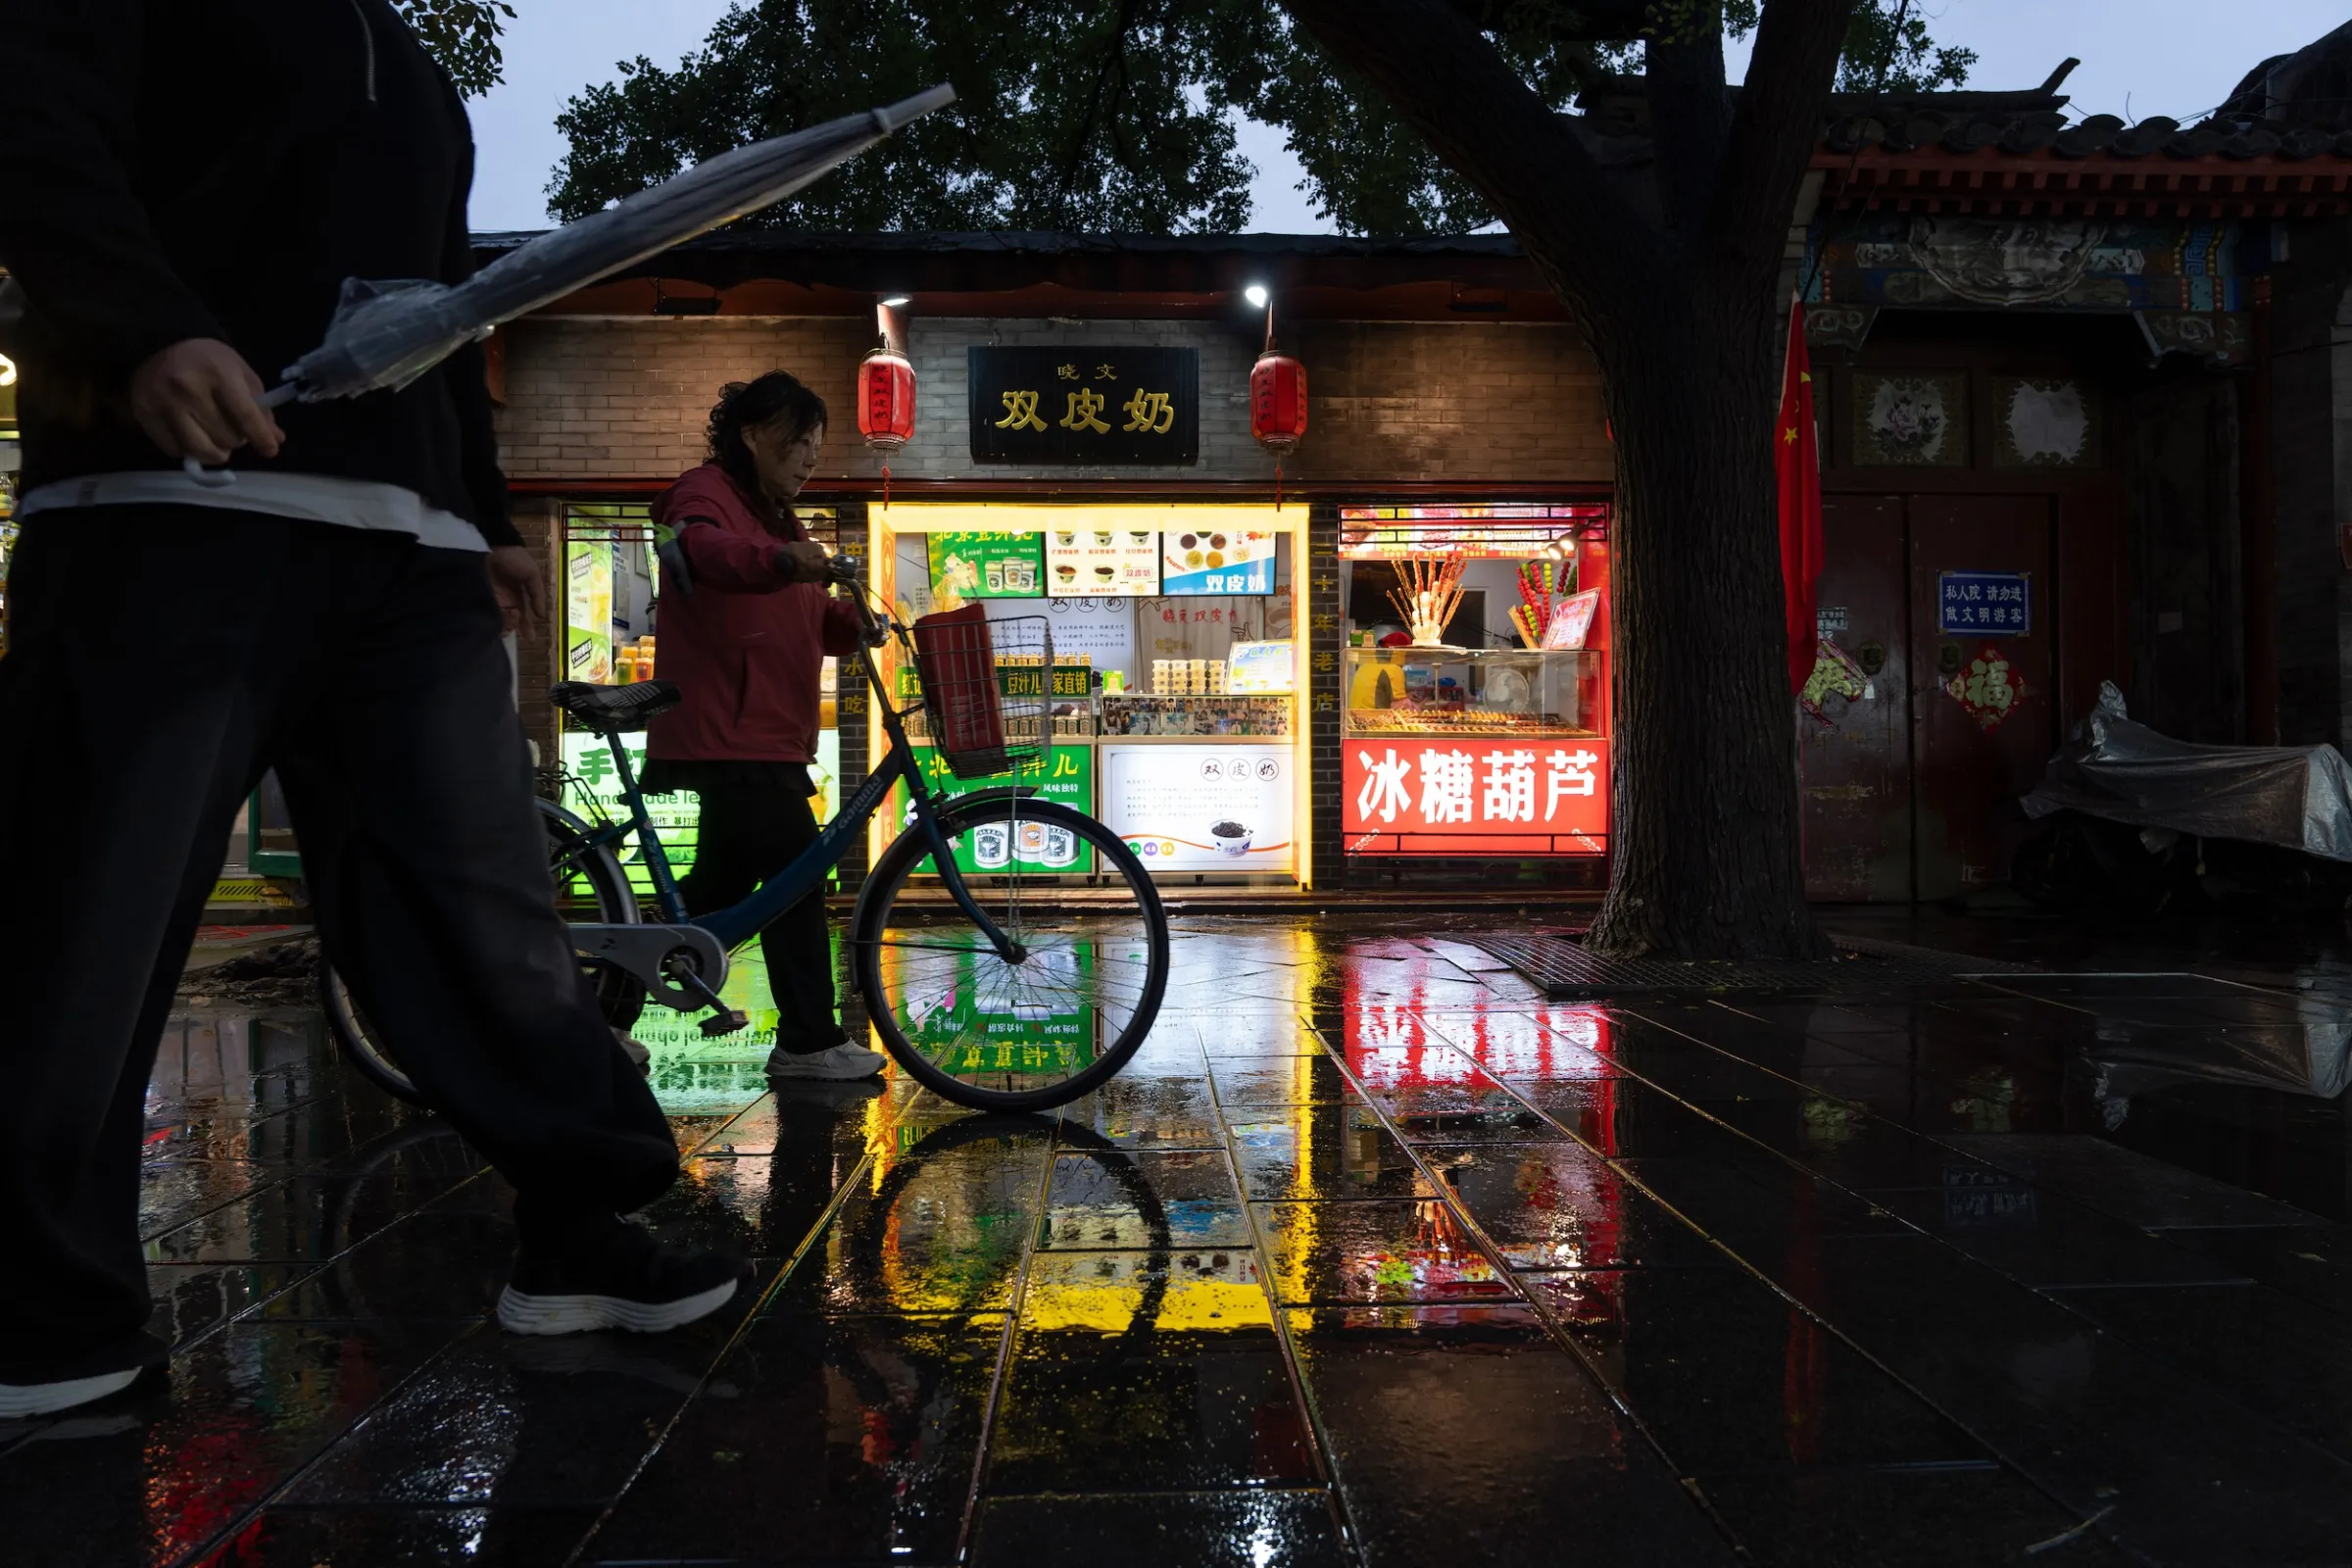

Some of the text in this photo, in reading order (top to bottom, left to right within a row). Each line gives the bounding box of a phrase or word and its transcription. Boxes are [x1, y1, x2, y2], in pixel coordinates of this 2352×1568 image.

[1057, 363, 1118, 381] 晓文
[996, 387, 1174, 434] 双皮奶
[1205, 574, 1266, 592] 双皮奶
[1945, 584, 2023, 602] 私人院 请勿进
[1945, 606, 2023, 623] 做文明游客
[1314, 543, 1334, 712] 二十年老店
[1966, 658, 2014, 710] 福
[1043, 783, 1079, 793] 风味独特
[1357, 748, 1598, 823] 冰糖葫芦
